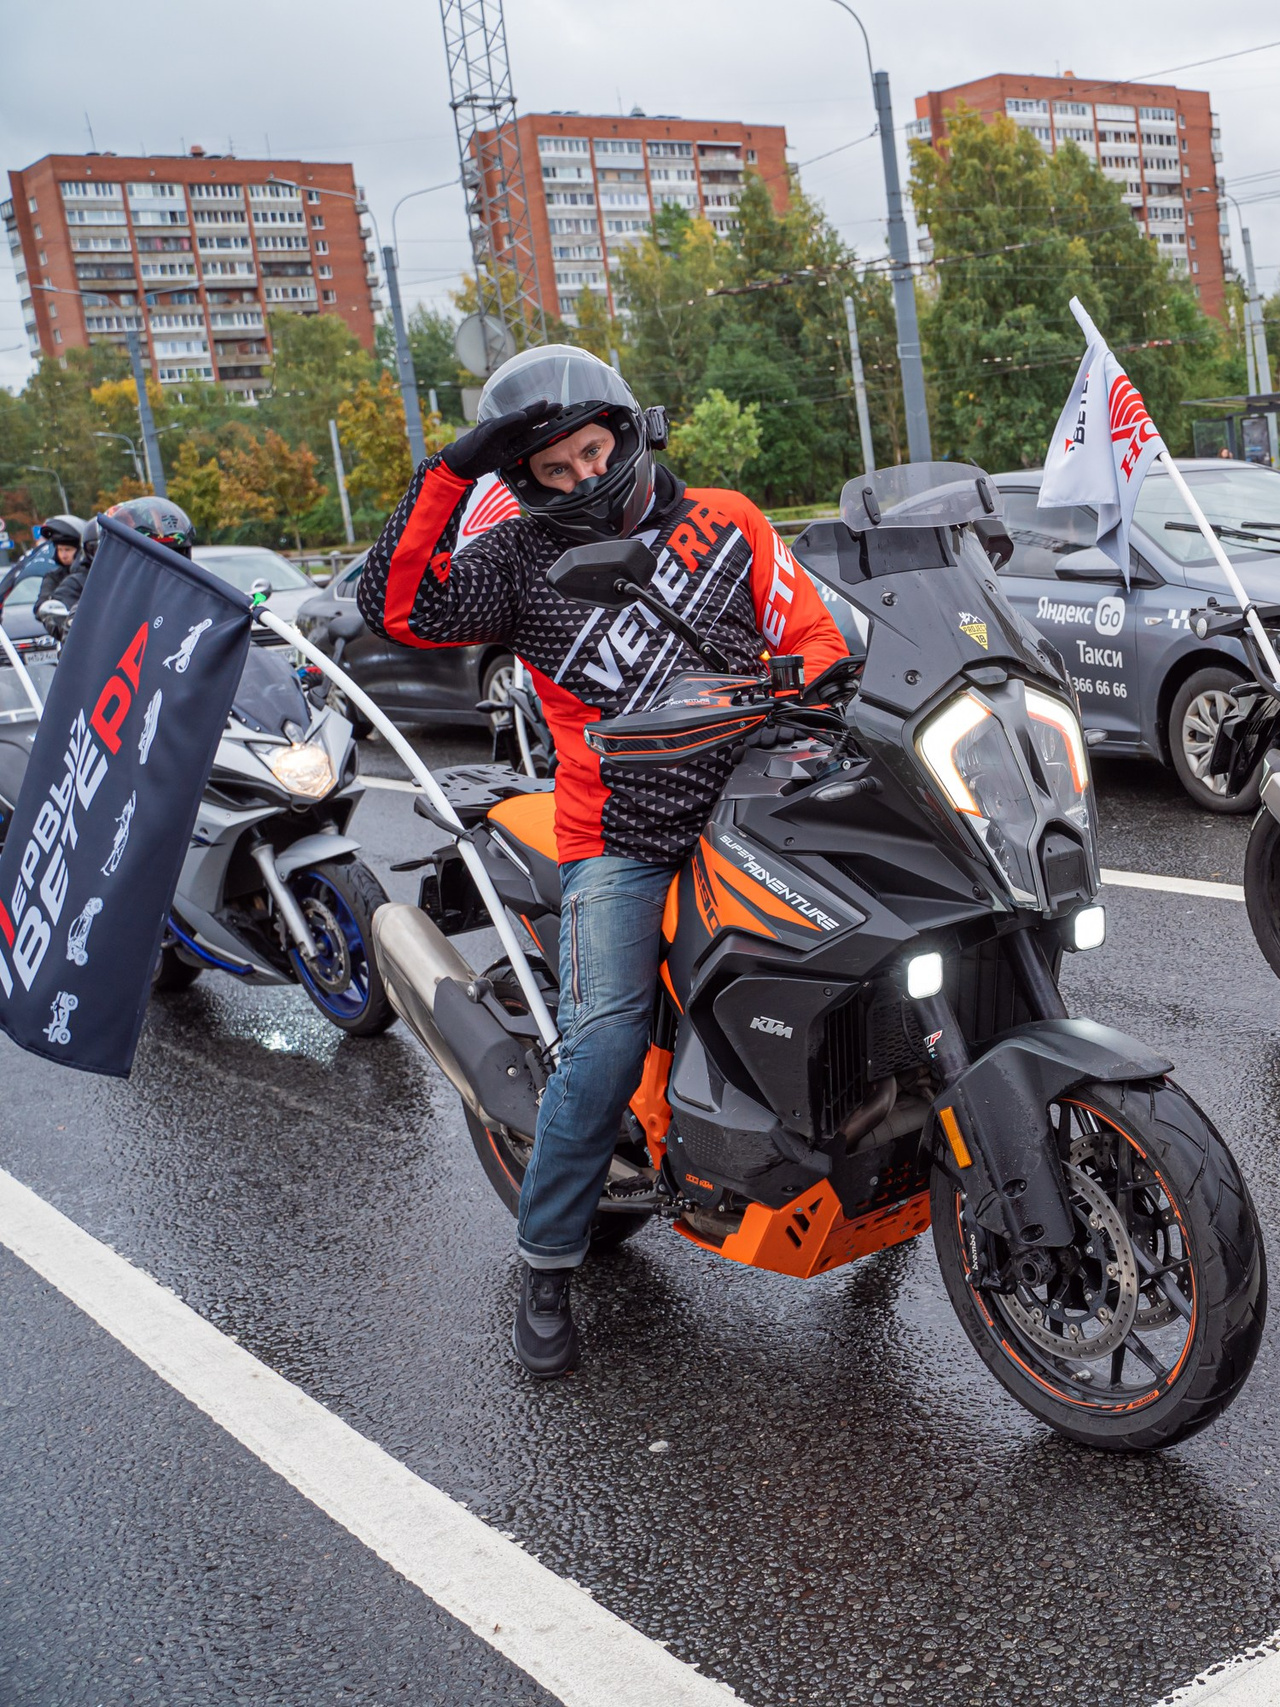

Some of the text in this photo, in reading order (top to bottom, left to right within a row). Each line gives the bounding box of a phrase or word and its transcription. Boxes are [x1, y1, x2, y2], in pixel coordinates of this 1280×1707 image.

[1036, 596, 1122, 630] Яндекс Go
[1076, 640, 1123, 669] Такси
[1072, 676, 1128, 698] 366 66 66
[719, 835, 840, 931] SUPER ADVENTURE
[750, 1016, 793, 1039] KTM
[969, 1233, 979, 1271] brembo
